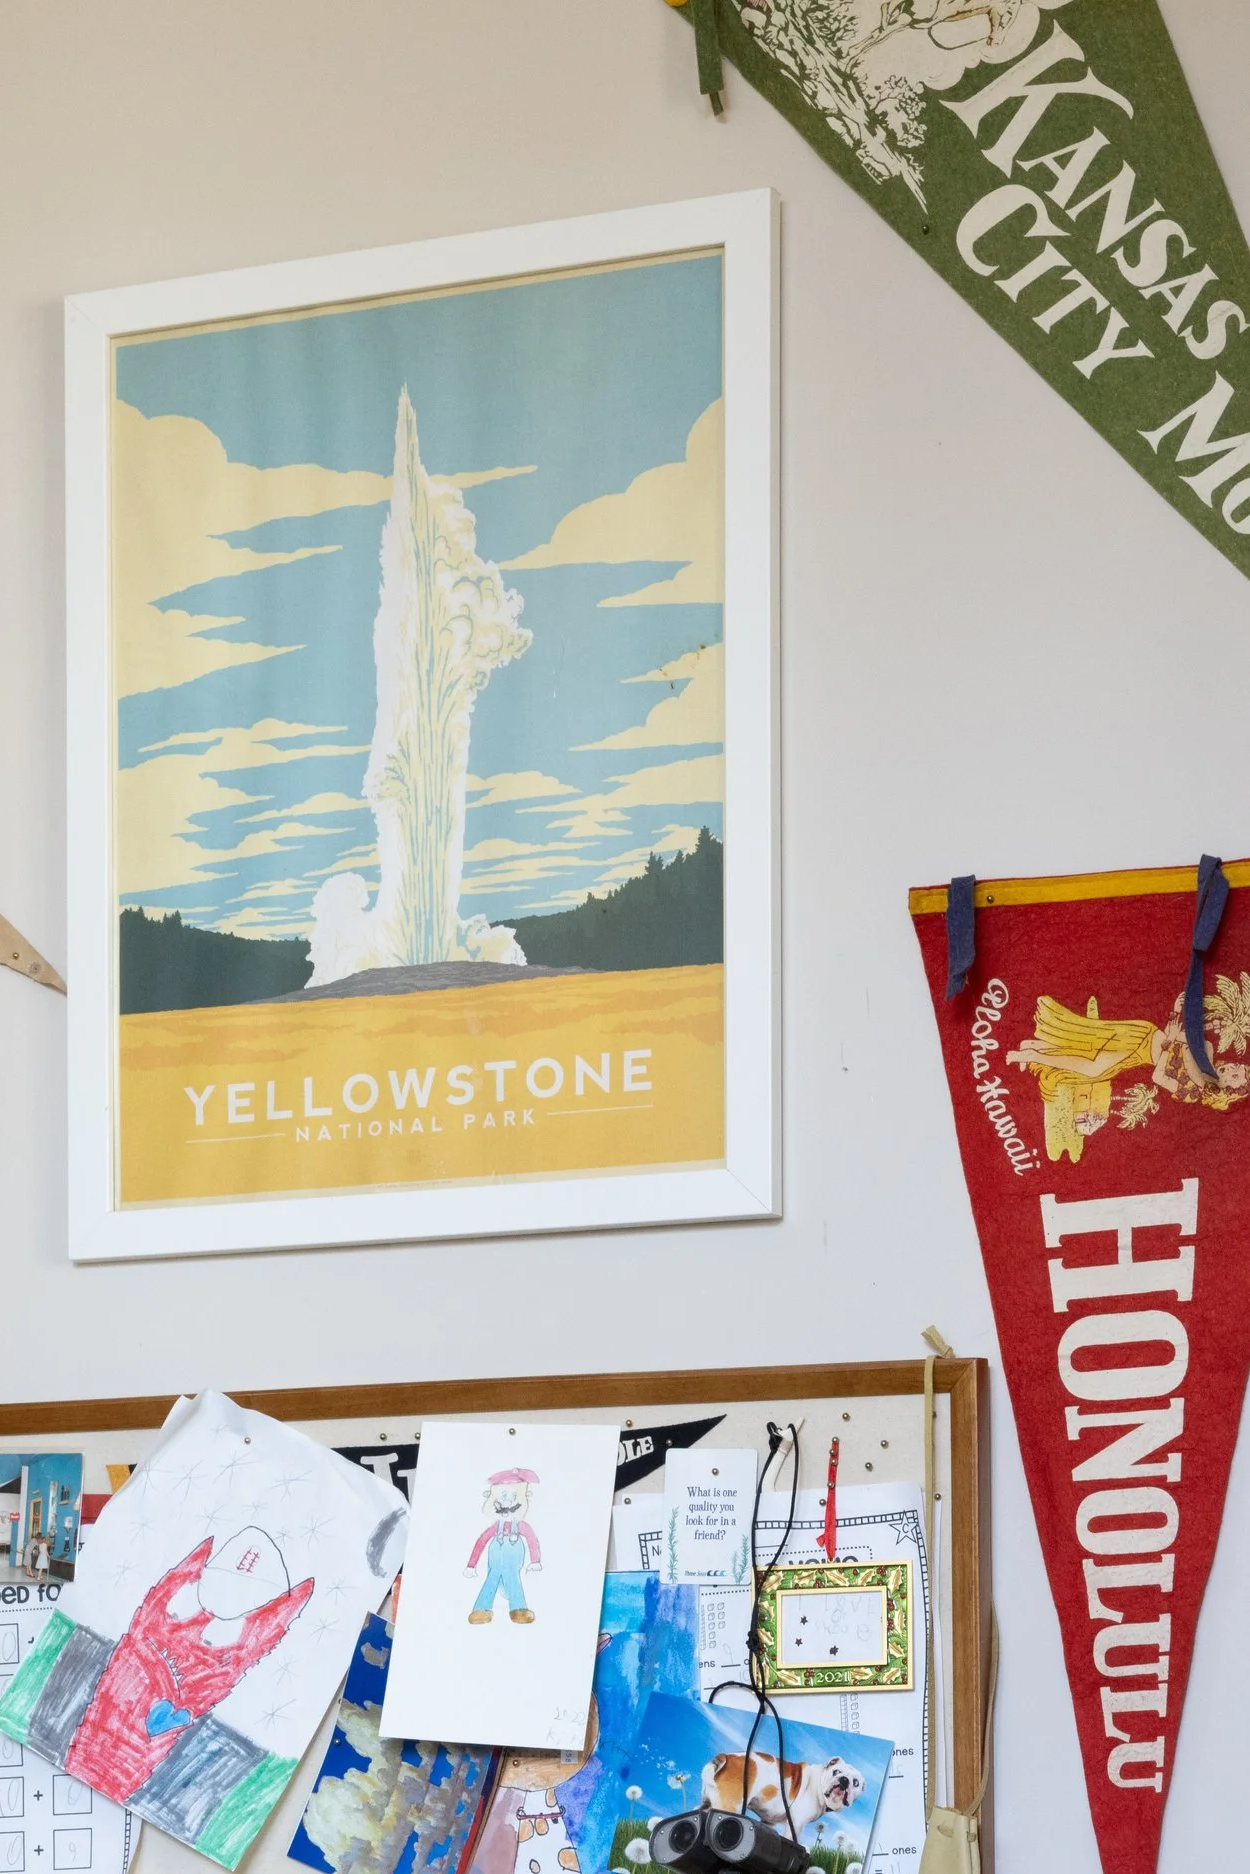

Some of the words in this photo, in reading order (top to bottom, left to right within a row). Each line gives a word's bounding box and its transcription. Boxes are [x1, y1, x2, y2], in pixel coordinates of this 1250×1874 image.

[940, 19, 1250, 360] KANSAS
[956, 184, 1155, 379] CITY
[971, 978, 1009, 1079] Aloha
[183, 1048, 653, 1126] YELLOWSTONE
[295, 1116, 443, 1143] NATIONAL
[463, 1108, 537, 1131] PARK
[976, 1075, 1041, 1176] Hawaii
[687, 1486, 712, 1498] What
[713, 1487, 721, 1497] is
[722, 1488, 738, 1498] one
[1040, 1177, 1200, 1794] HONOLULU
[685, 1515, 704, 1526] look
[704, 1515, 718, 1526] for
[720, 1515, 729, 1526] in
[730, 1518, 736, 1526] a
[688, 1501, 717, 1513] quality
[719, 1502, 735, 1513] you
[694, 1529, 726, 1541] friend?
[816, 1672, 850, 1684] 2021
[891, 1846, 917, 1855] ones
